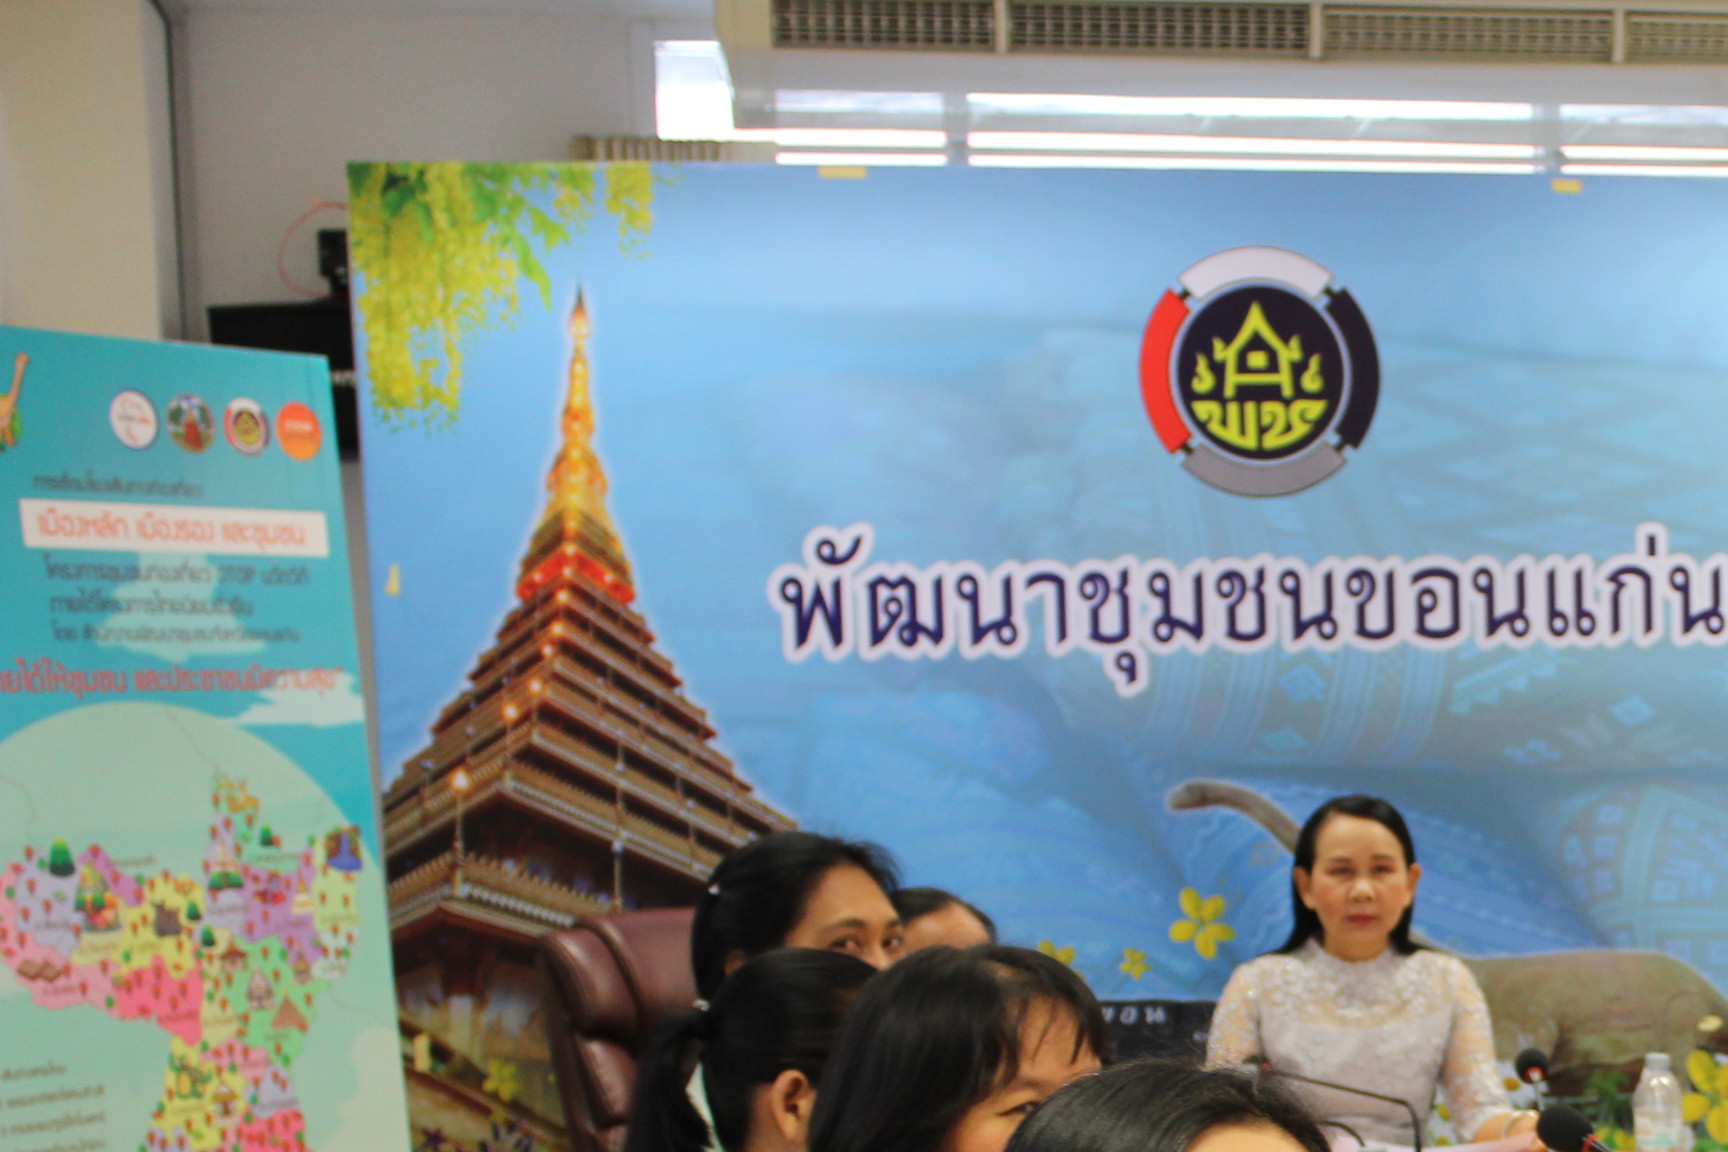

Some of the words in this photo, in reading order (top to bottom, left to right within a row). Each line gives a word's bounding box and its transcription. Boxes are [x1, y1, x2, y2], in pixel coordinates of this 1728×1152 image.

[38, 508, 130, 541] เมืองหลัก
[137, 511, 215, 544] เมืองรอง
[222, 523, 307, 551] และชุมชน
[778, 528, 1728, 686] พัฒนาชุมชนขอนแก่น
